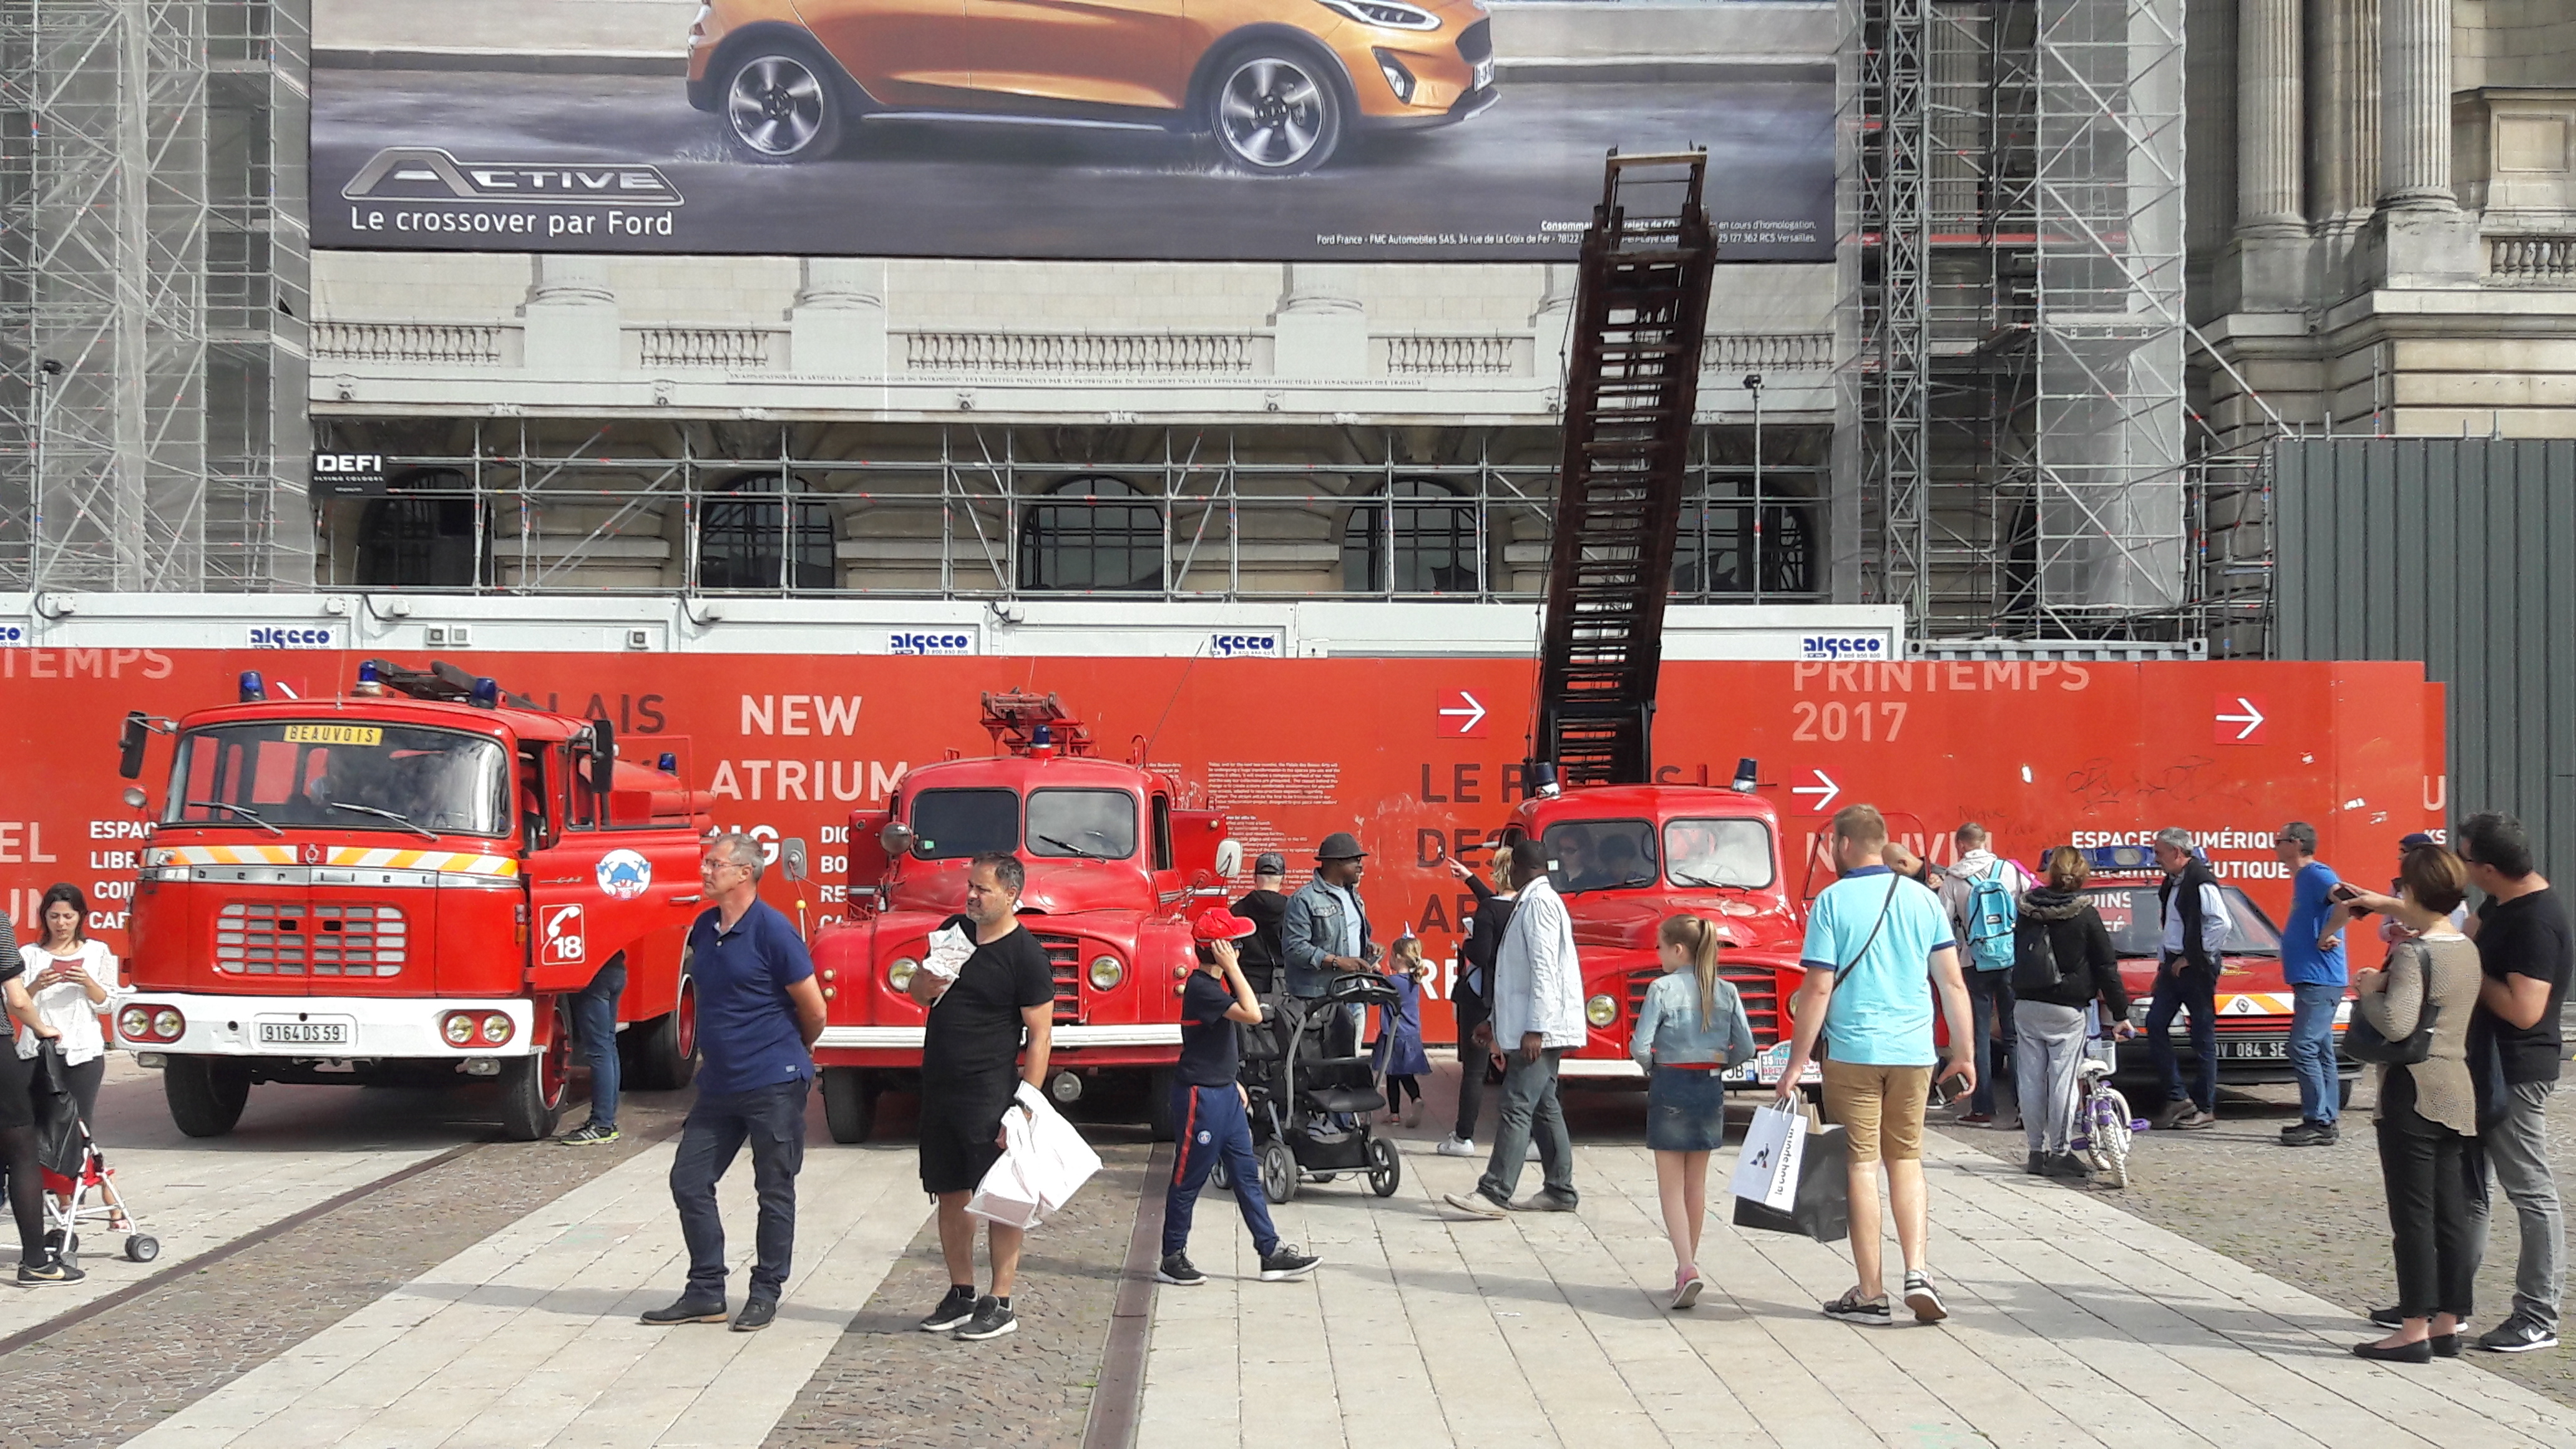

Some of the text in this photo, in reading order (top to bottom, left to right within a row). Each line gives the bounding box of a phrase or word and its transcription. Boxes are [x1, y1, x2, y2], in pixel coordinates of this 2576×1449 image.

[343, 149, 666, 197] ACTIVE
[350, 206, 674, 238] Le crossover par Ford
[1316, 233, 1335, 245] Ford
[1336, 233, 1363, 245] France
[1388, 233, 1438, 245] Automobiles
[1470, 234, 1483, 244] rue
[1484, 233, 1495, 244] de
[317, 454, 382, 472] DEFI
[890, 633, 968, 655] algeco
[1803, 636, 1881, 660] algeco
[1793, 662, 2091, 692] PRINTEMPS
[741, 694, 863, 736] NEW
[1792, 701, 1908, 743] 2017
[290, 726, 374, 743] BEAUVOIS
[710, 759, 909, 802] ATRIUM
[1421, 764, 1481, 803] LE
[552, 935, 583, 959] 18
[266, 1025, 340, 1041] 9164 DS 59
[2236, 1043, 2263, 1057] 084
[2270, 1042, 2286, 1057] SE
